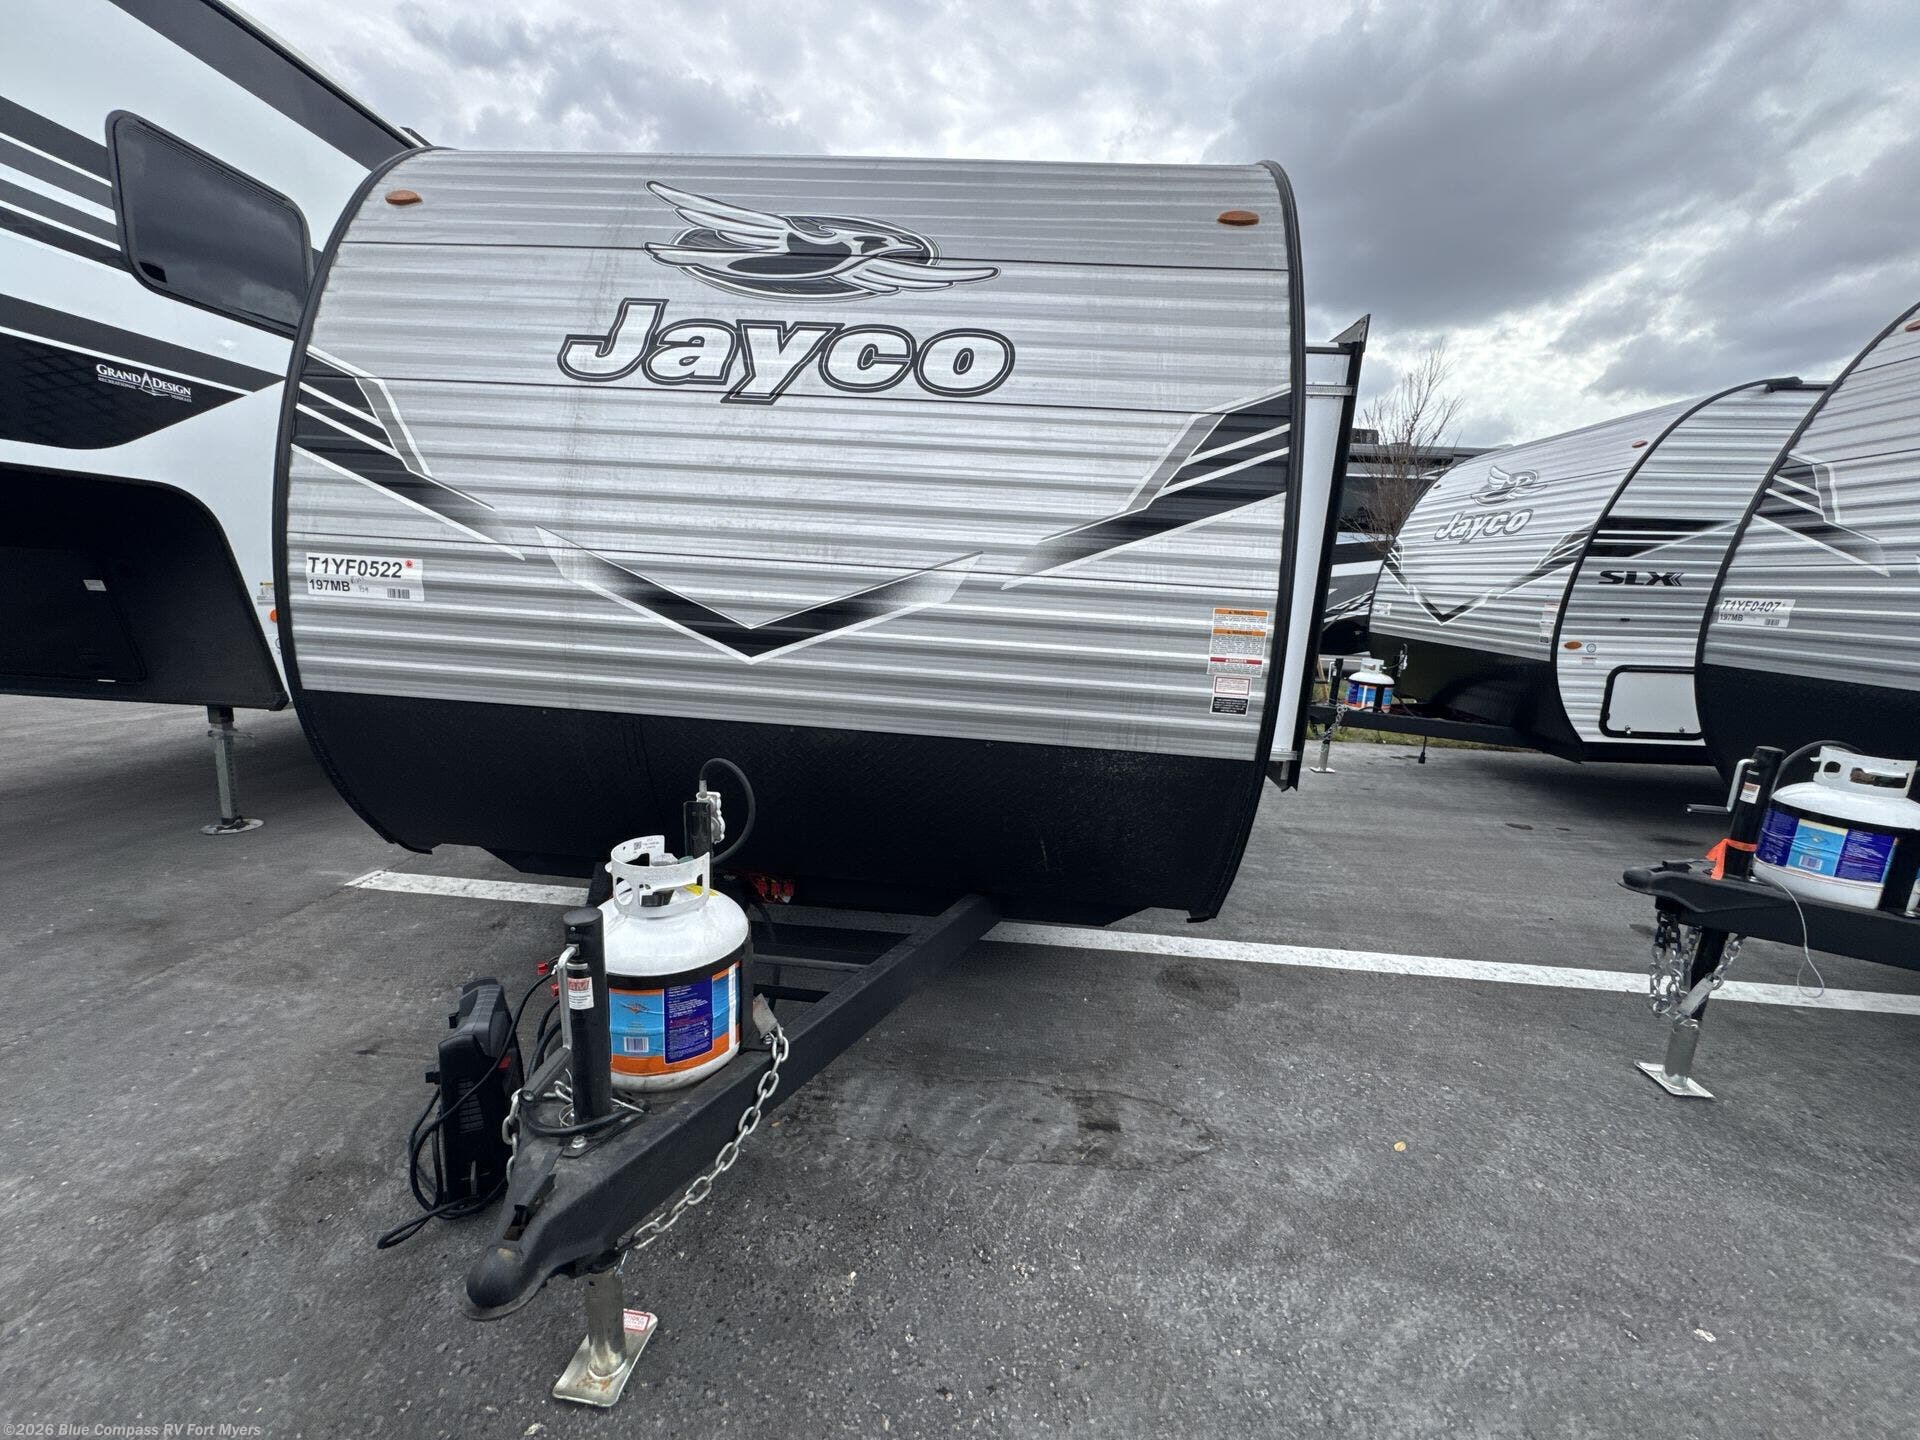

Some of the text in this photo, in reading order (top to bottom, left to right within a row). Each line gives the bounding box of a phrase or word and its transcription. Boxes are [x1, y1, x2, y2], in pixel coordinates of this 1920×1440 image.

[557, 298, 1015, 404] Jayco
[96, 364, 191, 396] GRAND DESIGN
[1434, 509, 1533, 544] Jayco
[308, 557, 402, 579] T1YF0522
[309, 579, 351, 592] 197MB
[1598, 570, 1684, 587] SLX
[1722, 599, 1782, 612] T1YF0407
[1720, 613, 1743, 622] 197MB
